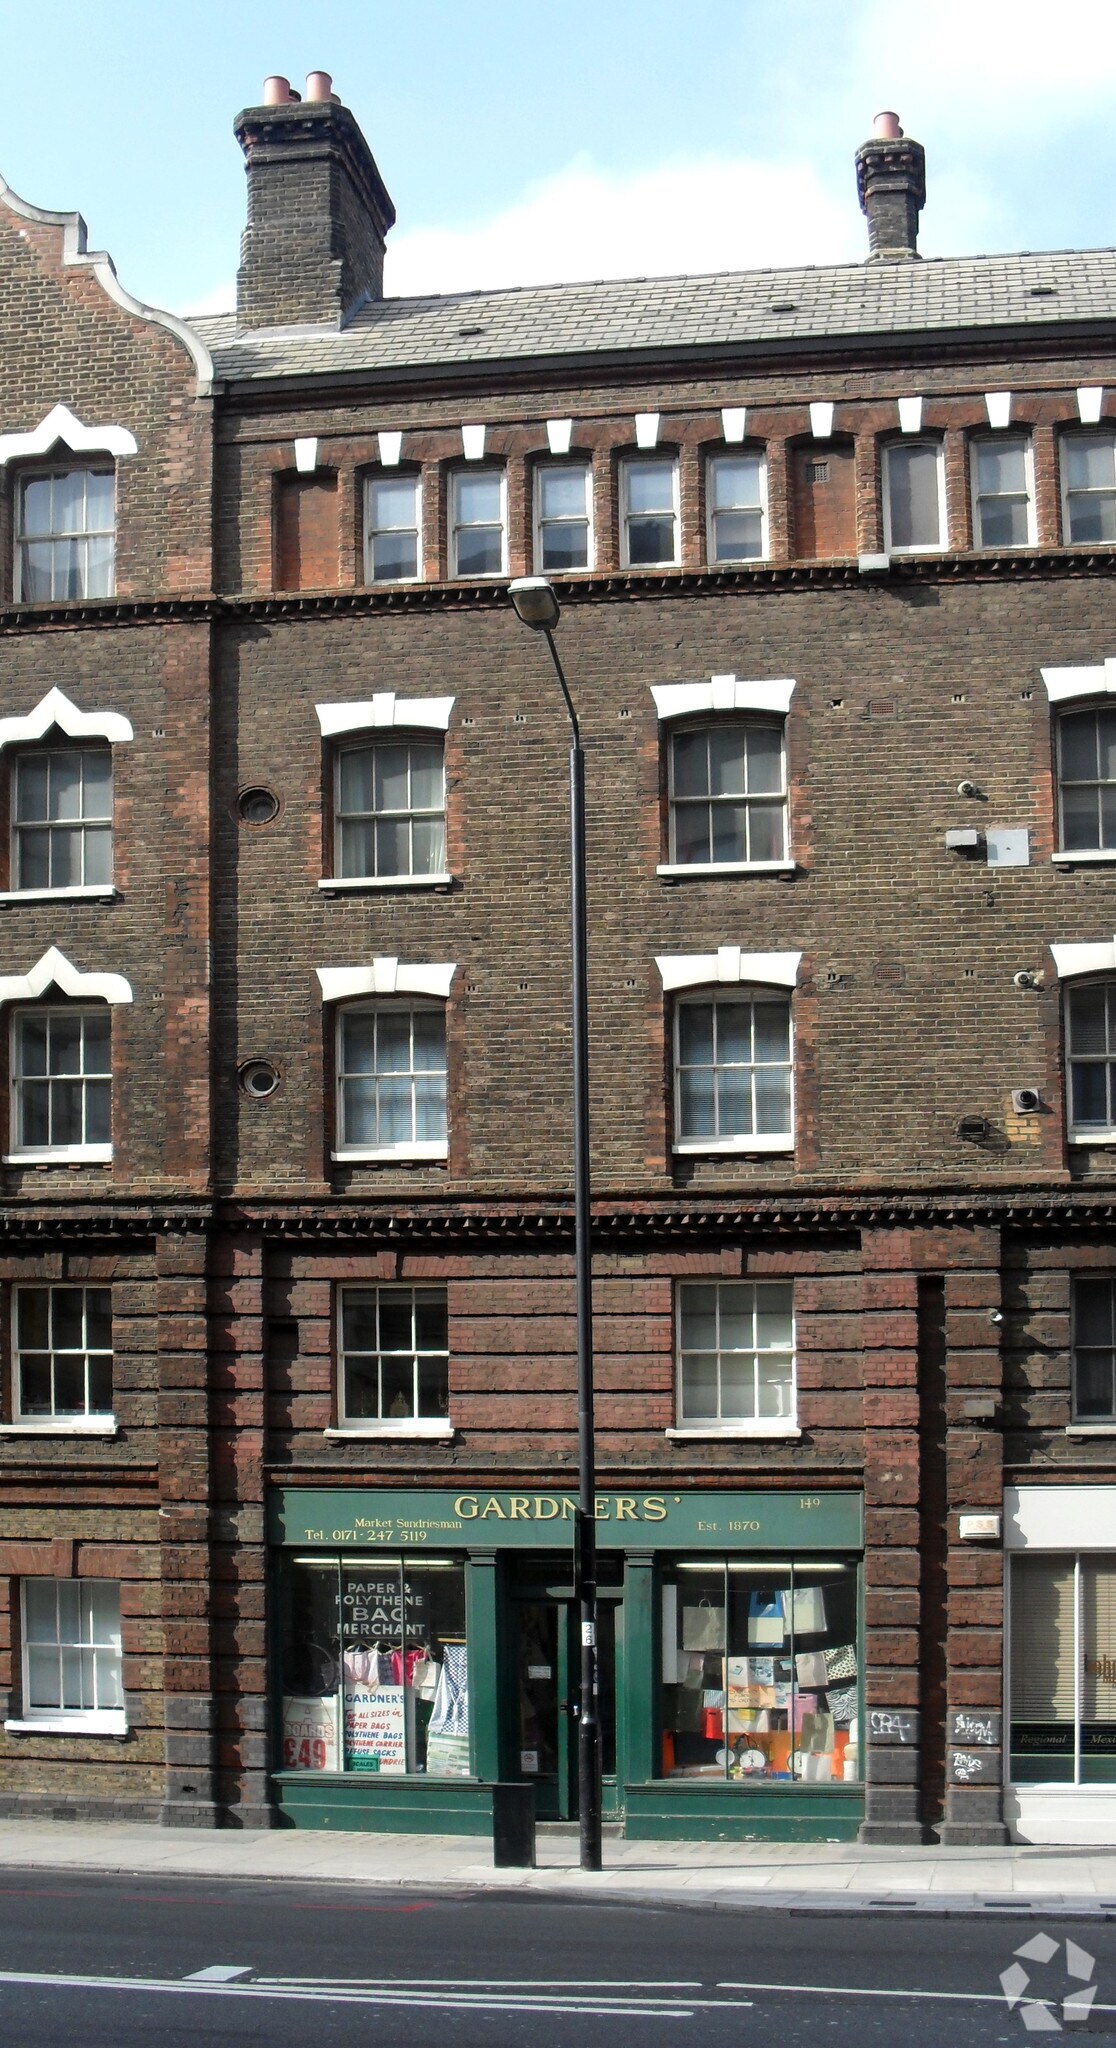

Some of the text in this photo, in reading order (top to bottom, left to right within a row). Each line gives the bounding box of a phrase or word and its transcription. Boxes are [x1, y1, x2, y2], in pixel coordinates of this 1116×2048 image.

[800, 1498, 821, 1509] 149
[354, 1518, 463, 1529] Market Sundriesman
[698, 1521, 760, 1531] Est. 1870
[304, 1529, 329, 1540] Tel.
[399, 1530, 427, 1541] 5119
[347, 1583, 396, 1594] PAPER
[335, 1594, 424, 1606] POLYTHENE
[352, 1607, 408, 1622] BAG
[336, 1623, 426, 1635] MERCHANT
[283, 1724, 334, 1738] BOARDS
[370, 1721, 391, 1730] BAGS
[382, 1731, 403, 1740] BAGS
[283, 1737, 326, 1769] £49
